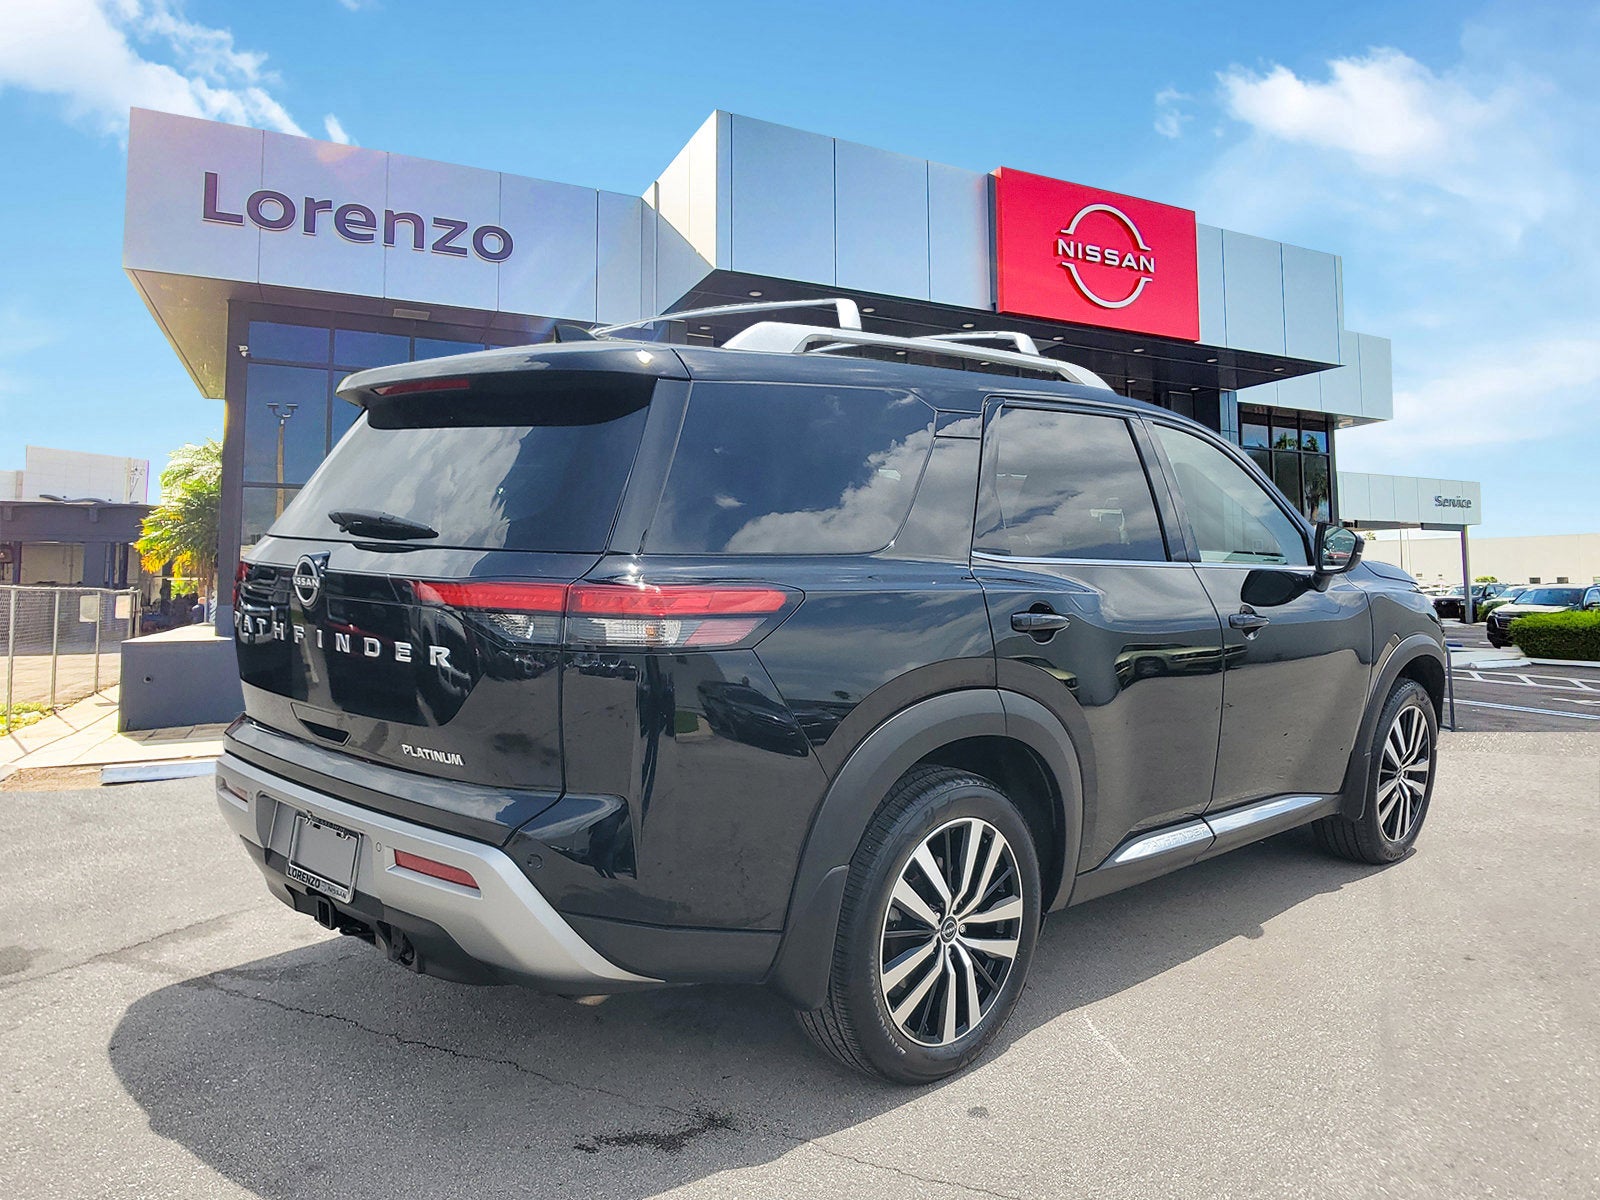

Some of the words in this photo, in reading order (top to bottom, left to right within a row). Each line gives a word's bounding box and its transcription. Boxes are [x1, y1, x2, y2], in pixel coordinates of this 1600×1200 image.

[202, 171, 514, 262] Lorenzo
[1057, 238, 1156, 273] NISSAN
[1434, 495, 1472, 508] Service
[234, 610, 451, 668] PATHFINDER
[401, 743, 464, 766] PLATINUM
[287, 866, 321, 889] LORENZO
